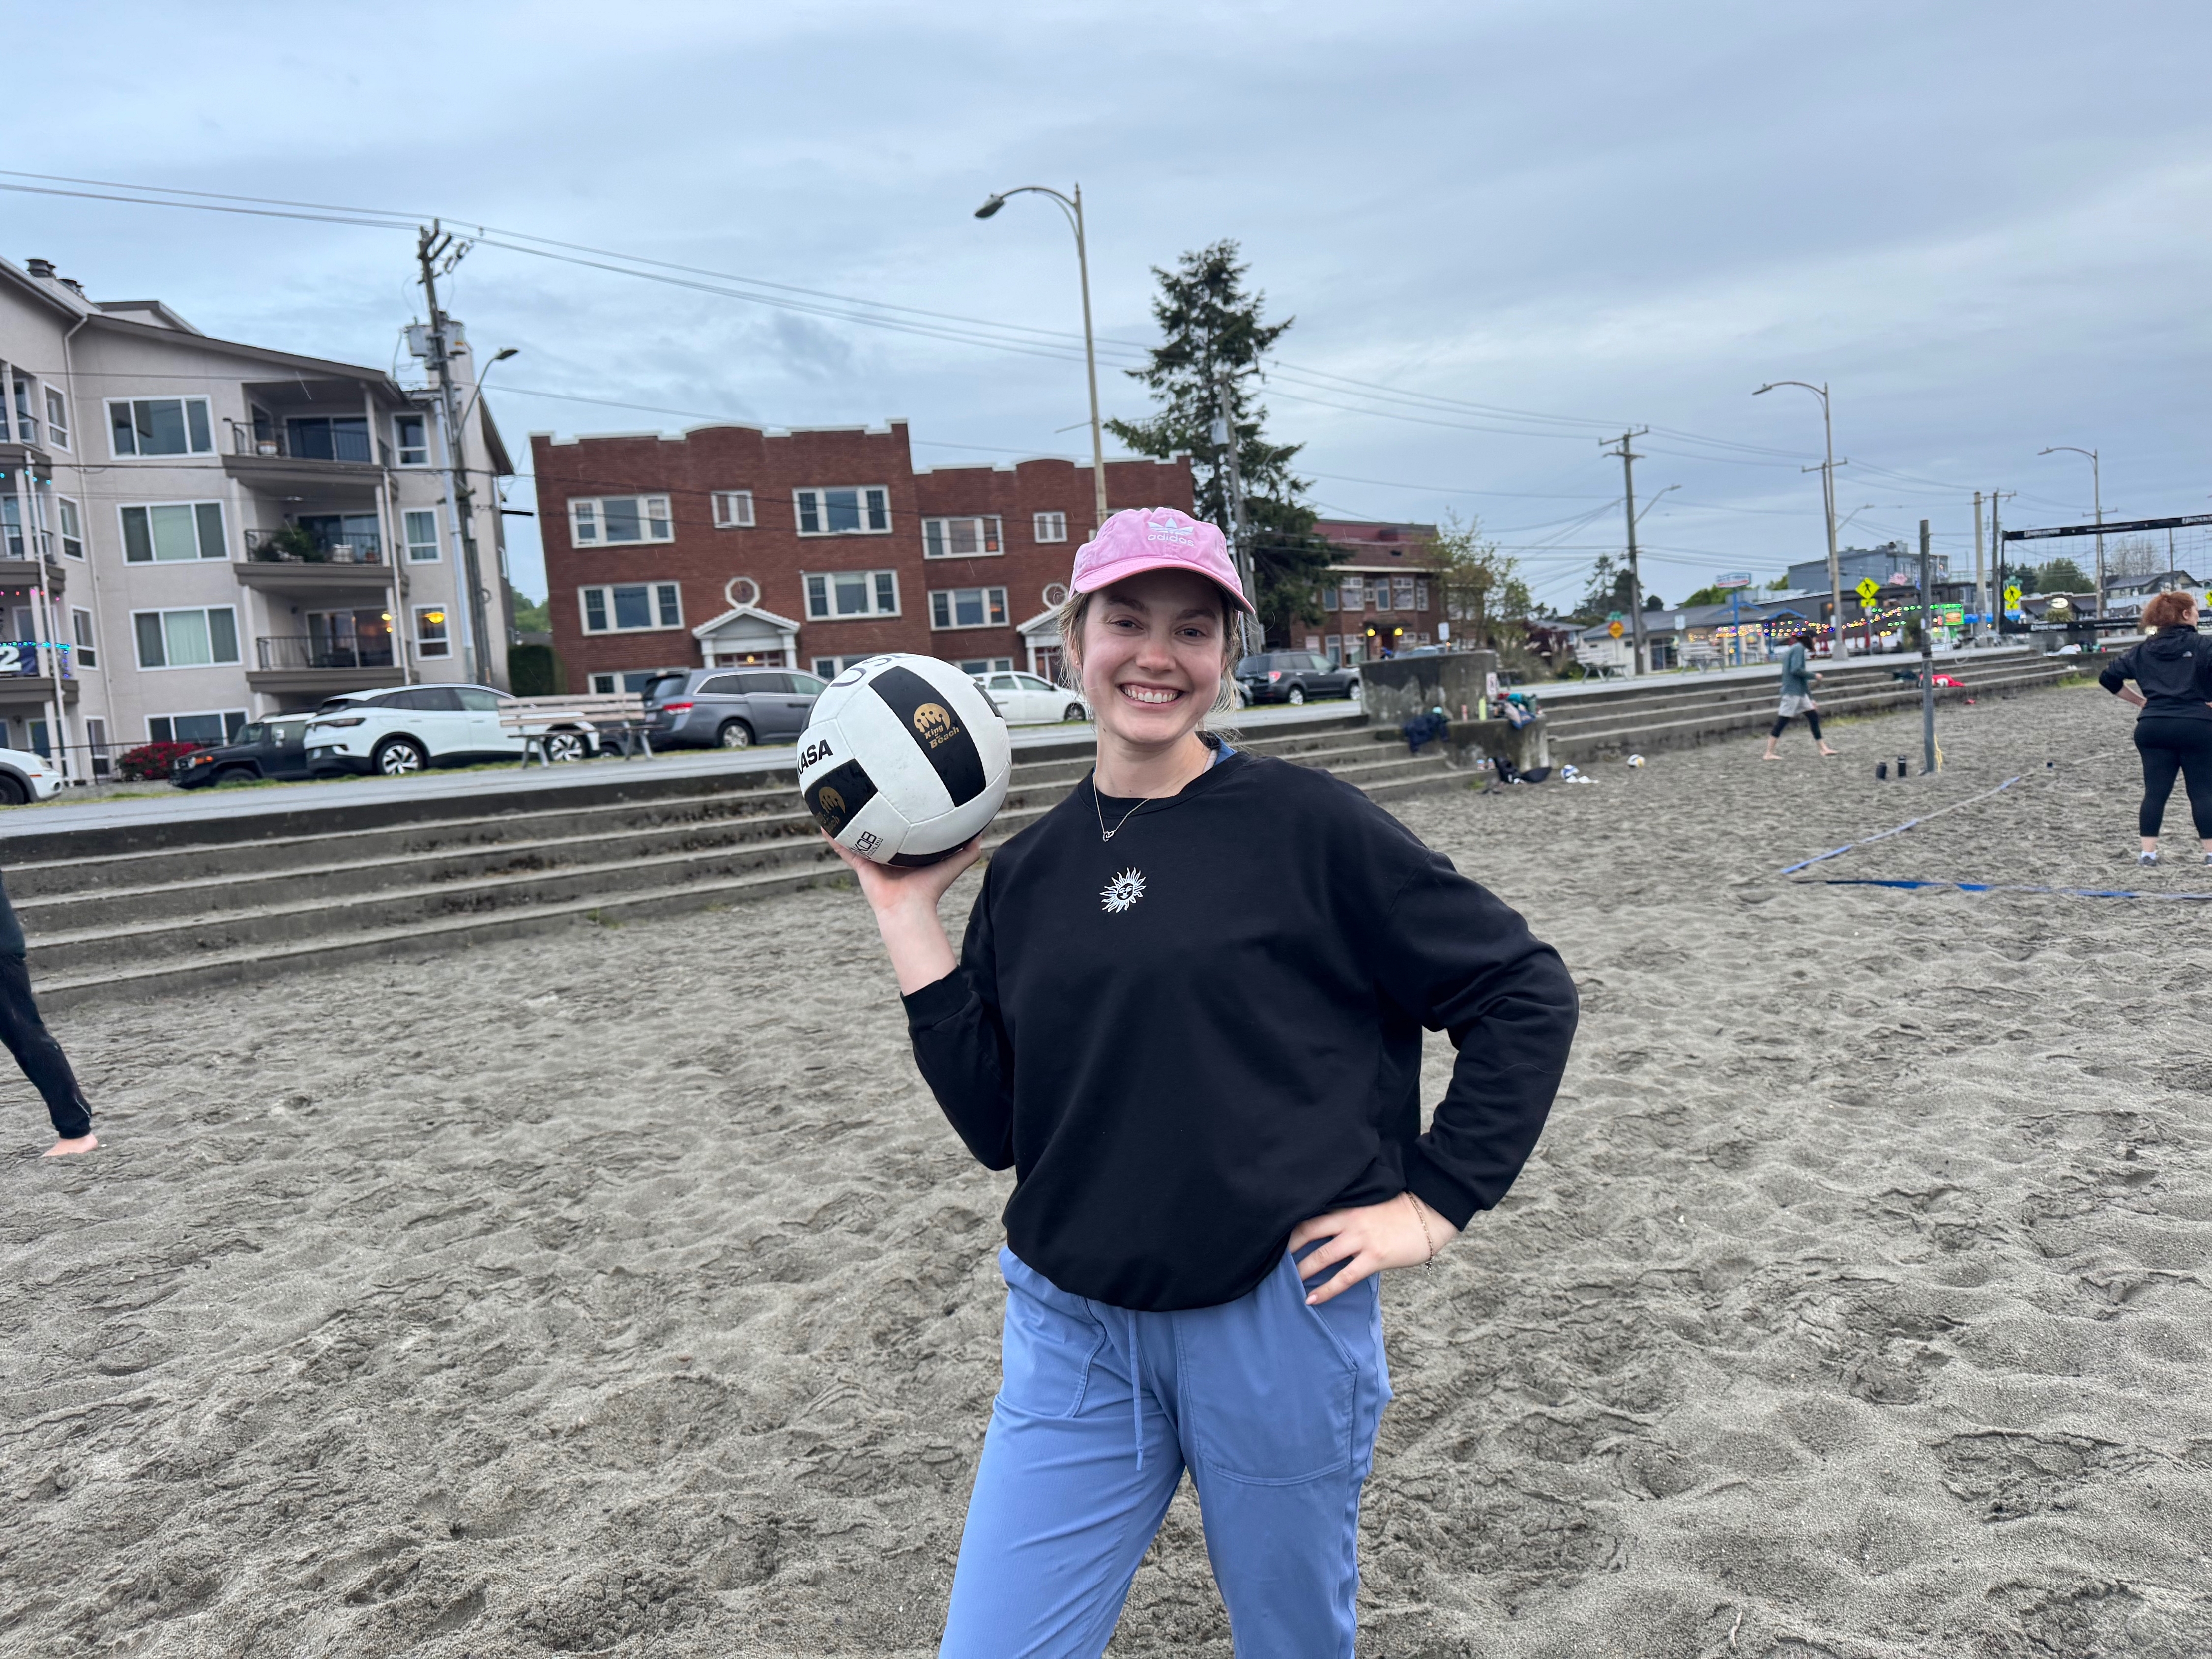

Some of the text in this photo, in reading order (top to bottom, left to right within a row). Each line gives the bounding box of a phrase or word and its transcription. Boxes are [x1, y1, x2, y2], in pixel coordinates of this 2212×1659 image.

[1147, 533, 1194, 547] adidas
[0, 646, 22, 672] 2
[924, 725, 943, 739] King
